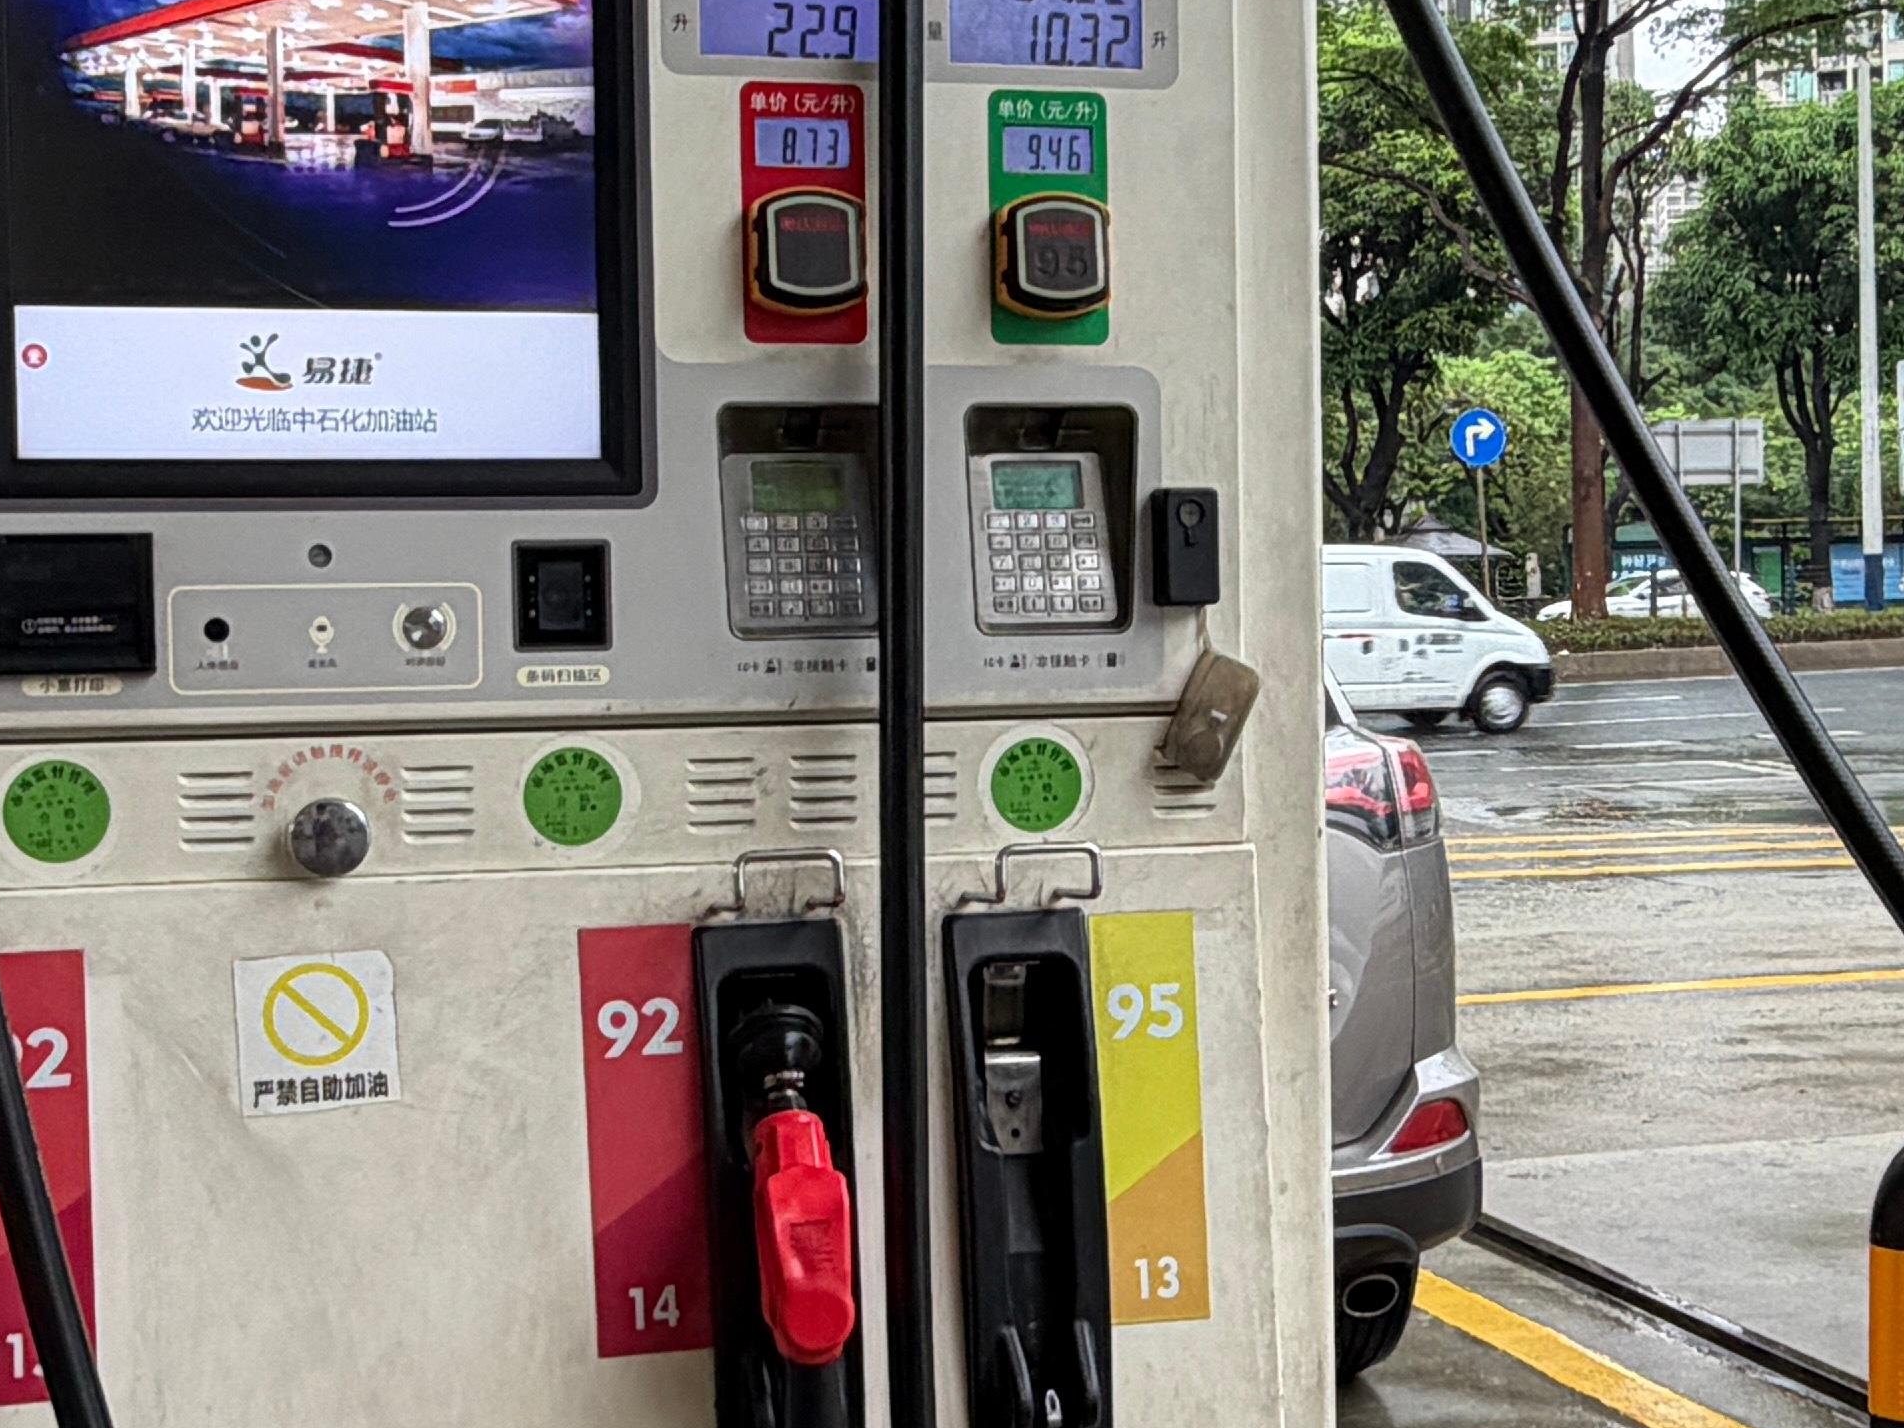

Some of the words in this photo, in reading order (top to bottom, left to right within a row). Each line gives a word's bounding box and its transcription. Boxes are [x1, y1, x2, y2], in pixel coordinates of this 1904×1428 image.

[671, 12, 689, 33] 升
[1030, 12, 1130, 68] 10.32
[1151, 30, 1168, 50] 升
[782, 127, 839, 166] 8.73
[1028, 134, 1082, 171] 9.46
[303, 357, 375, 386] 易捷
[192, 407, 438, 434] 欢迎光临中石化加油站
[597, 998, 684, 1059] 92
[1106, 983, 1184, 1039] 95
[253, 1071, 389, 1108] 严禁自助加油
[1134, 1256, 1180, 1299] 13
[628, 1283, 680, 1330] 14
